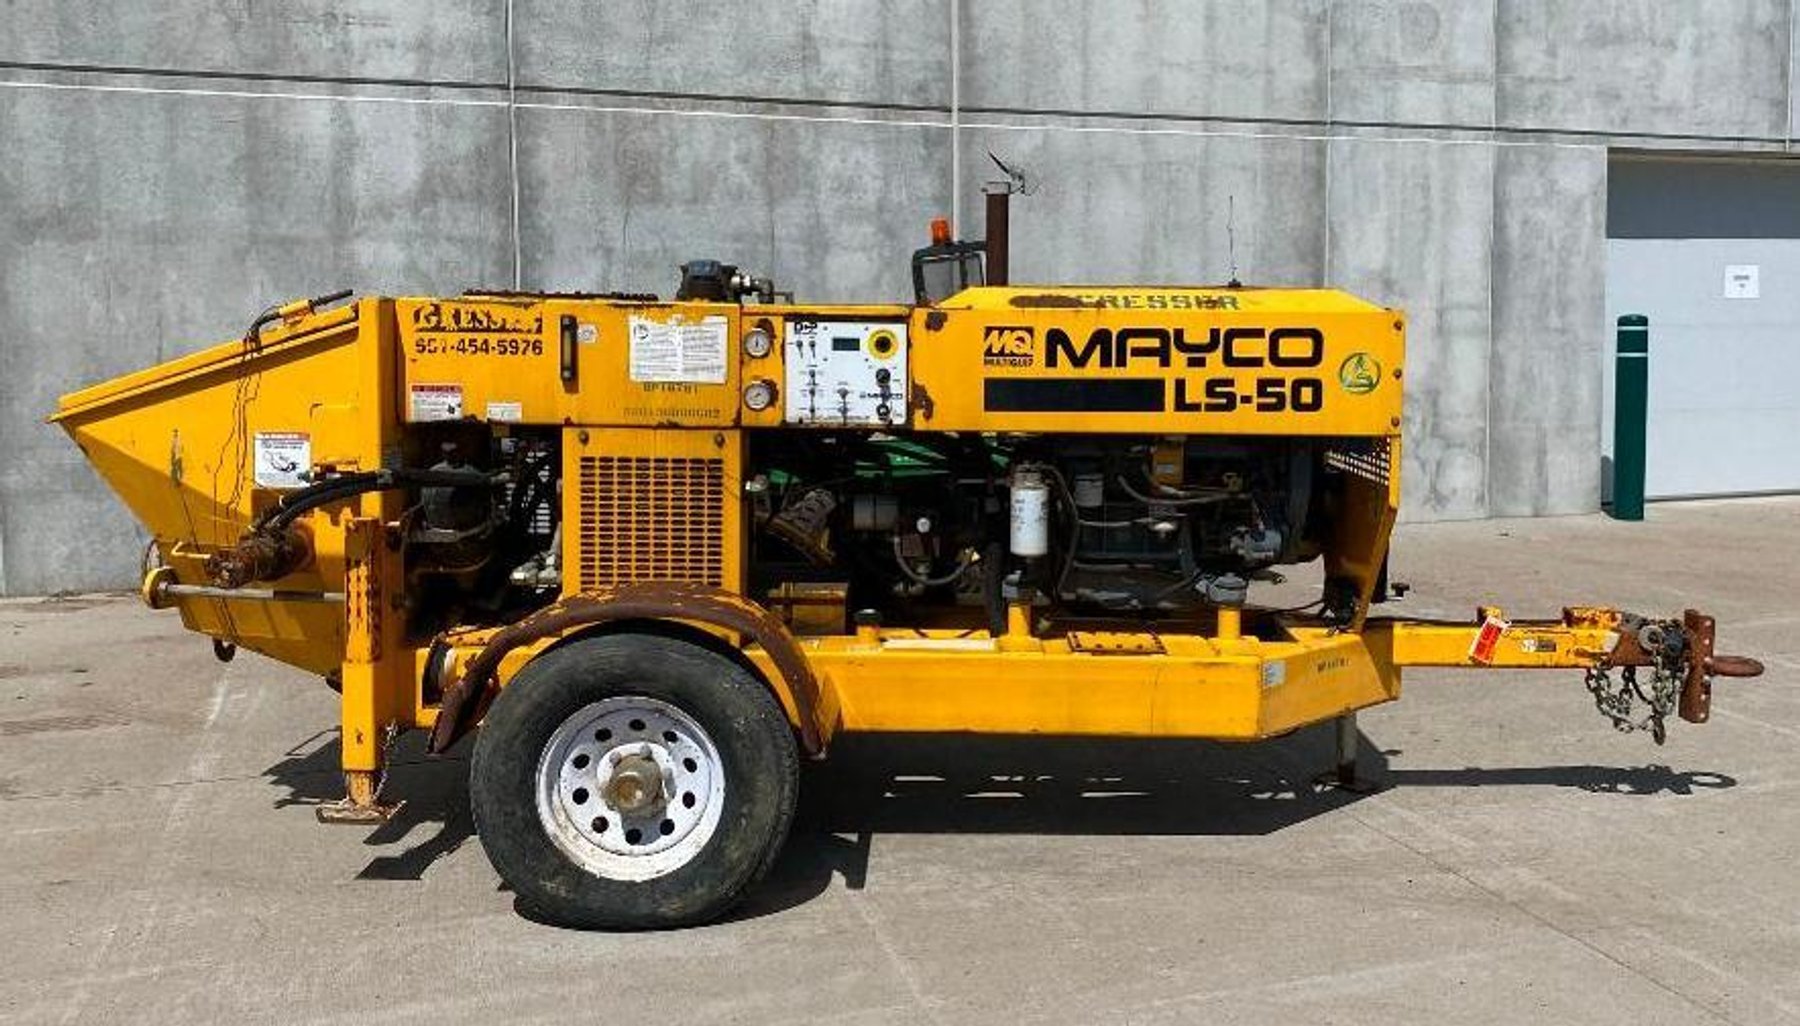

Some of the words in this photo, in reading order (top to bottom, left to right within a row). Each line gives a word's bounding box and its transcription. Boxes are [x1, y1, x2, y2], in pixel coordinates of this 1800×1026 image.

[984, 326, 1034, 356] MQ
[1045, 328, 1324, 368] MAYCO
[1174, 379, 1323, 412] LS-50
